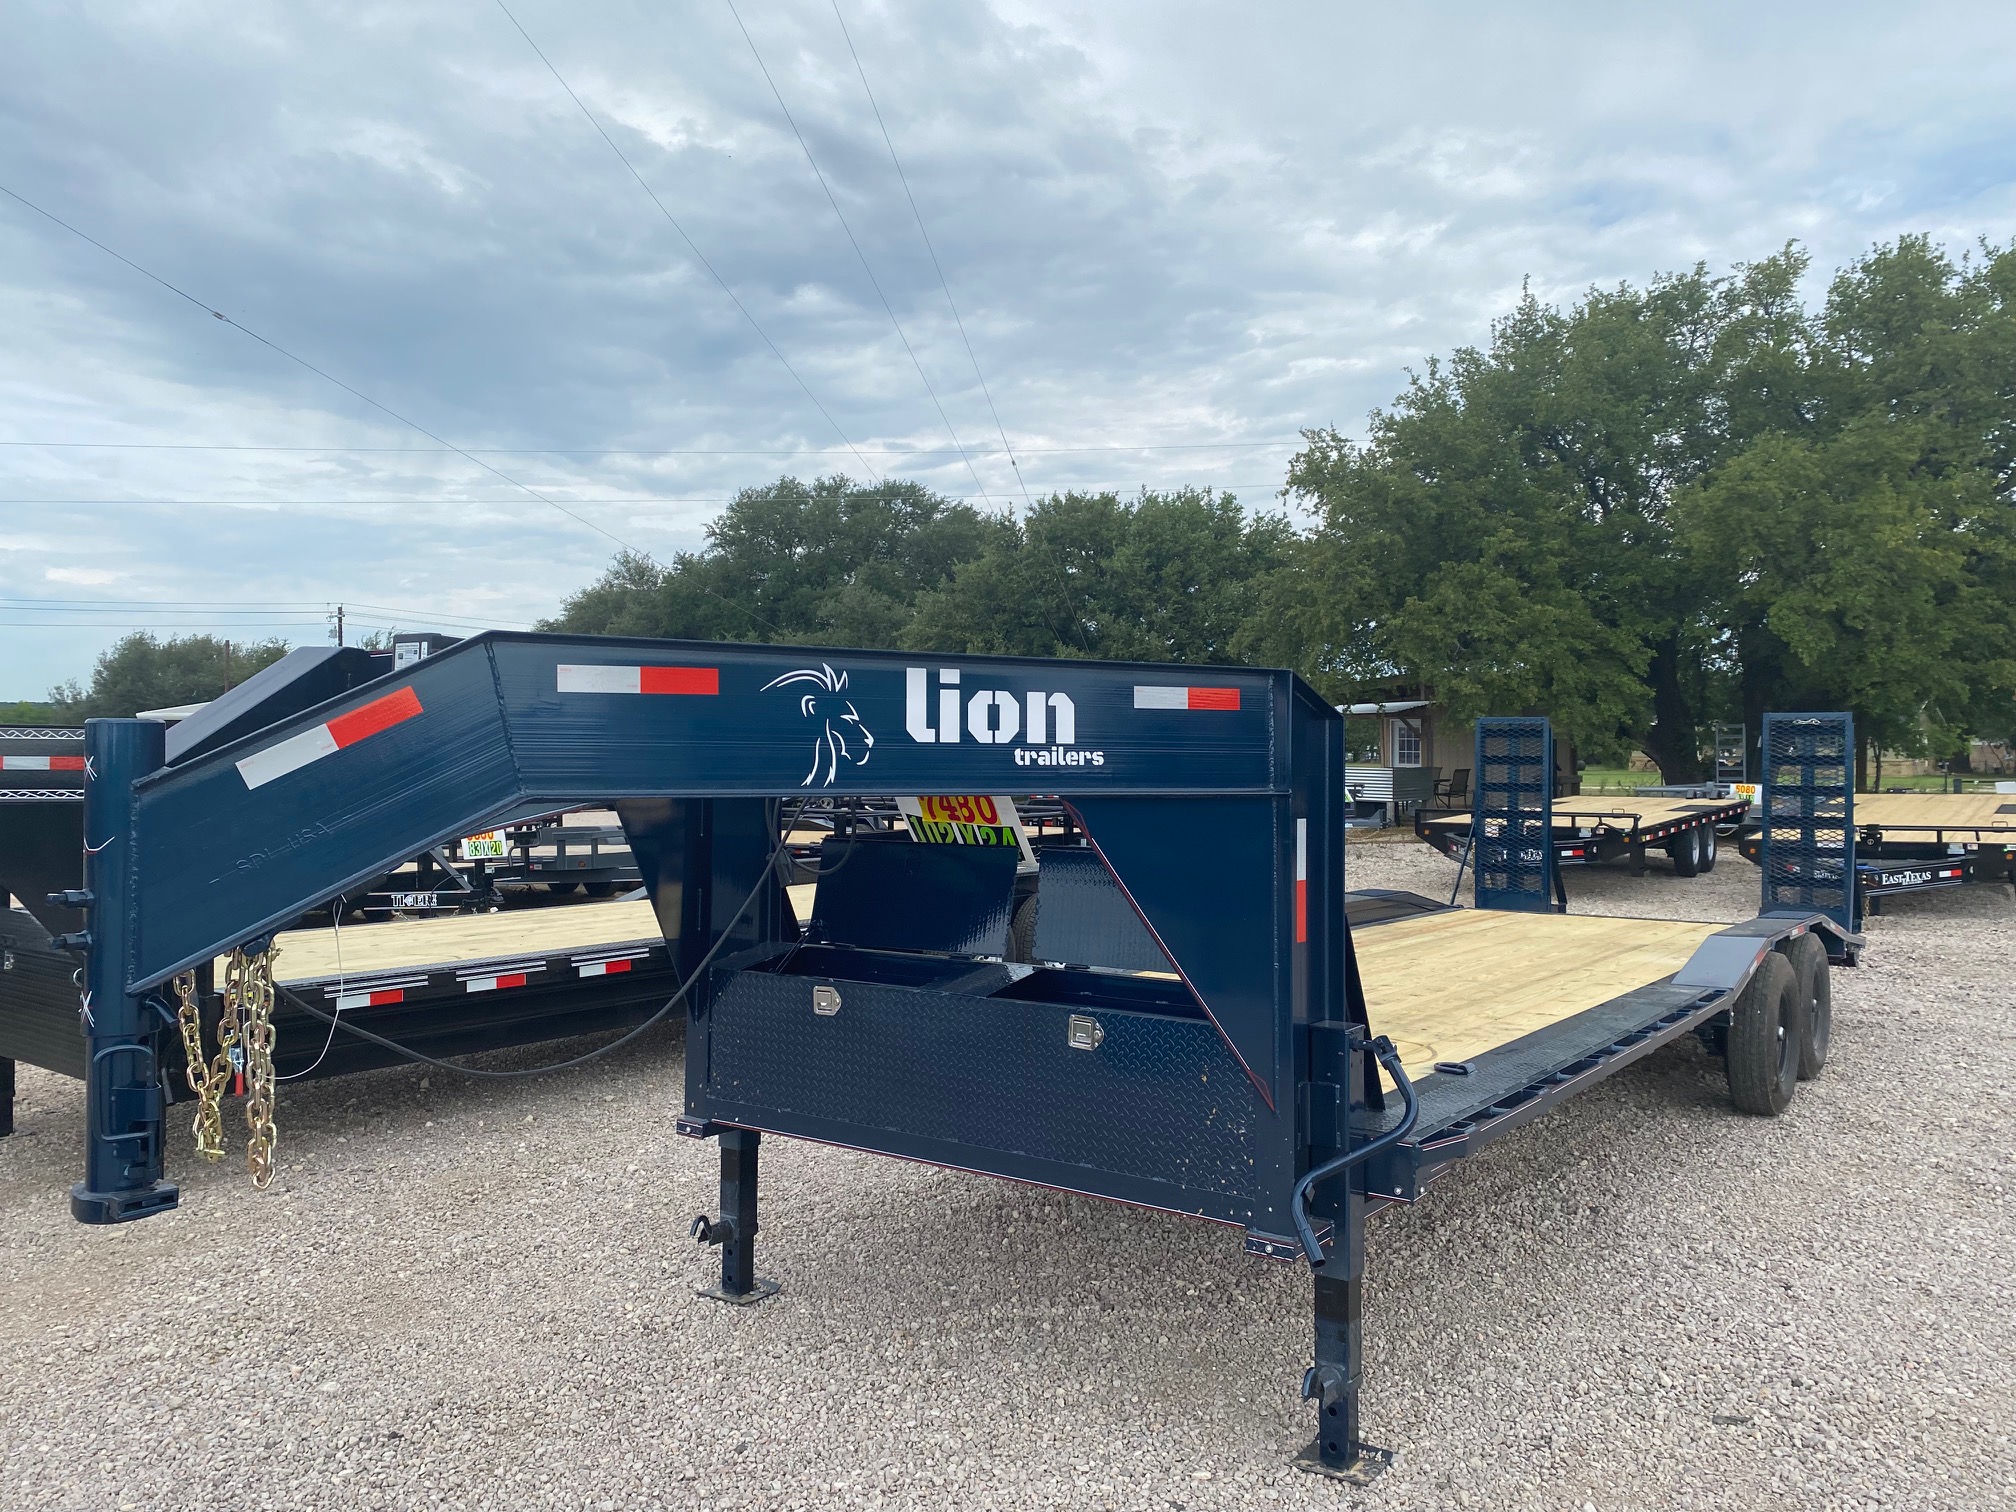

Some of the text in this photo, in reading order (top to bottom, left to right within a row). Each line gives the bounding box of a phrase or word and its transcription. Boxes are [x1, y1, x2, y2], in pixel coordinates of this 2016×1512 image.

[906, 667, 1075, 744] lion
[1014, 746, 1105, 766] trailers
[918, 796, 998, 825] 7480
